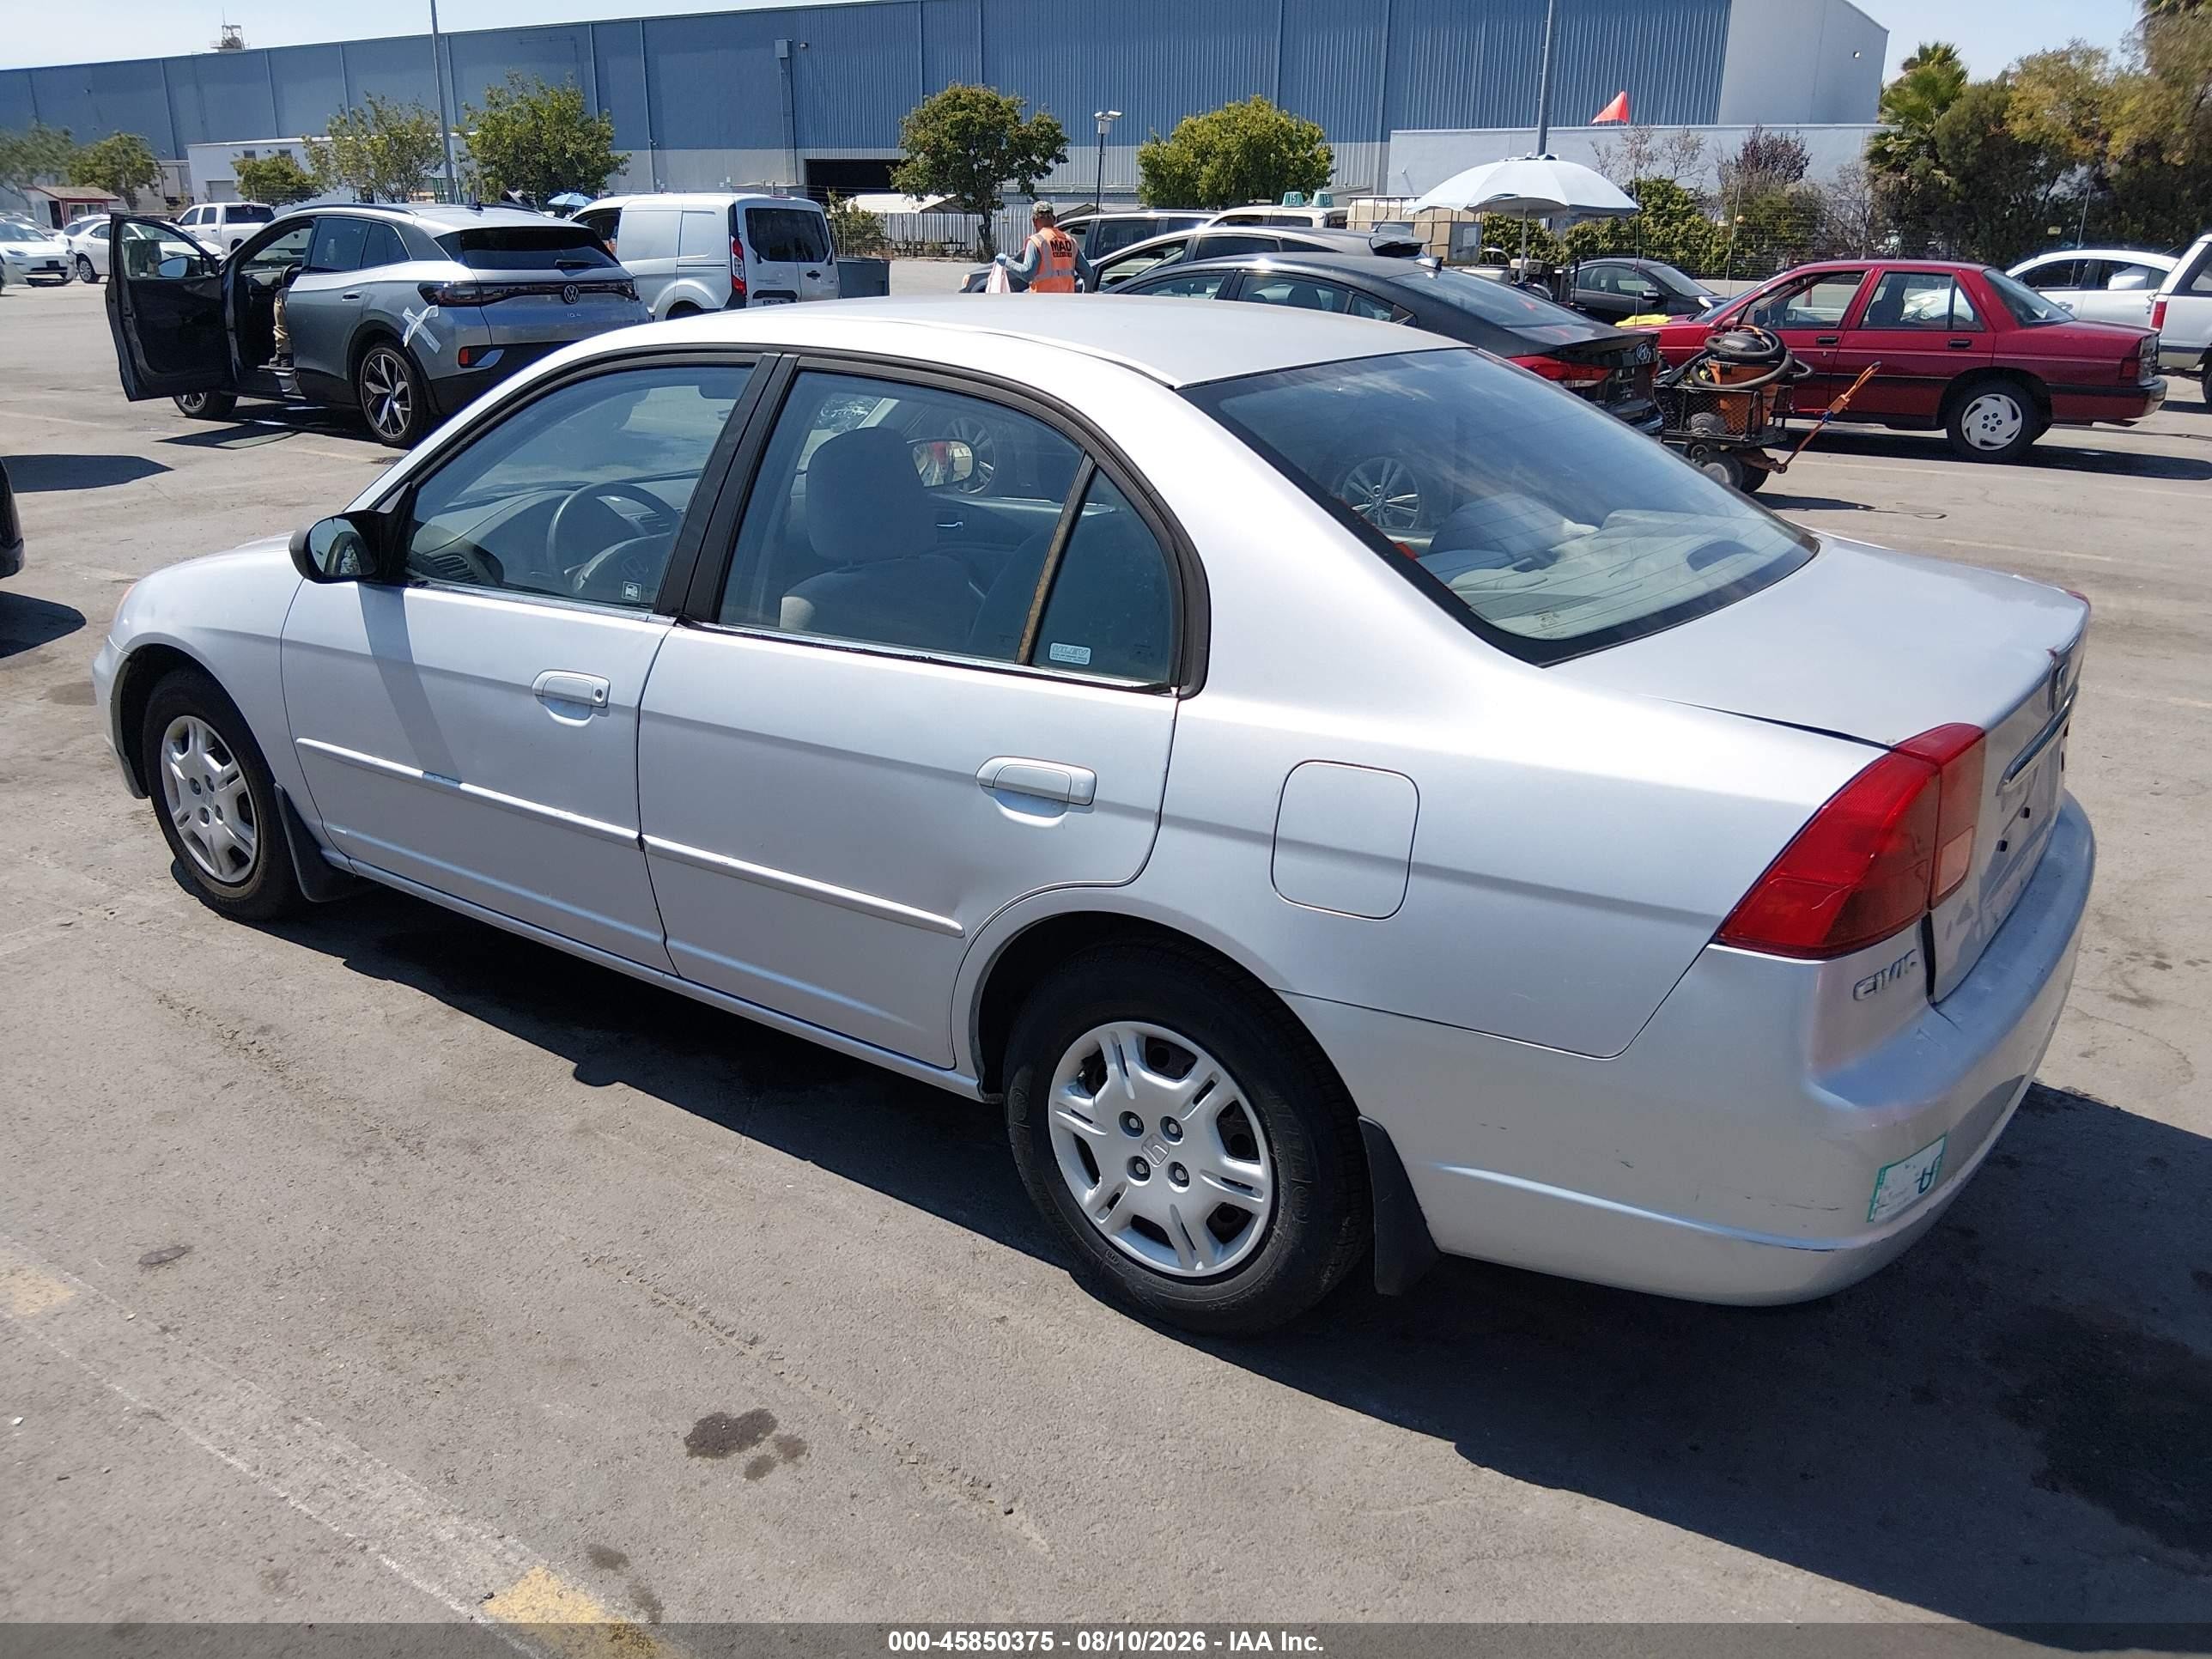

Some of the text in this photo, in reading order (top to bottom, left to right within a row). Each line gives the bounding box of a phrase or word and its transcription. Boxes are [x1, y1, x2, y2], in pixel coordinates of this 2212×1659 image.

[1289, 193, 1297, 204] 15
[1050, 240, 1072, 252] MAD
[1853, 948, 1917, 1001] CIVIC
